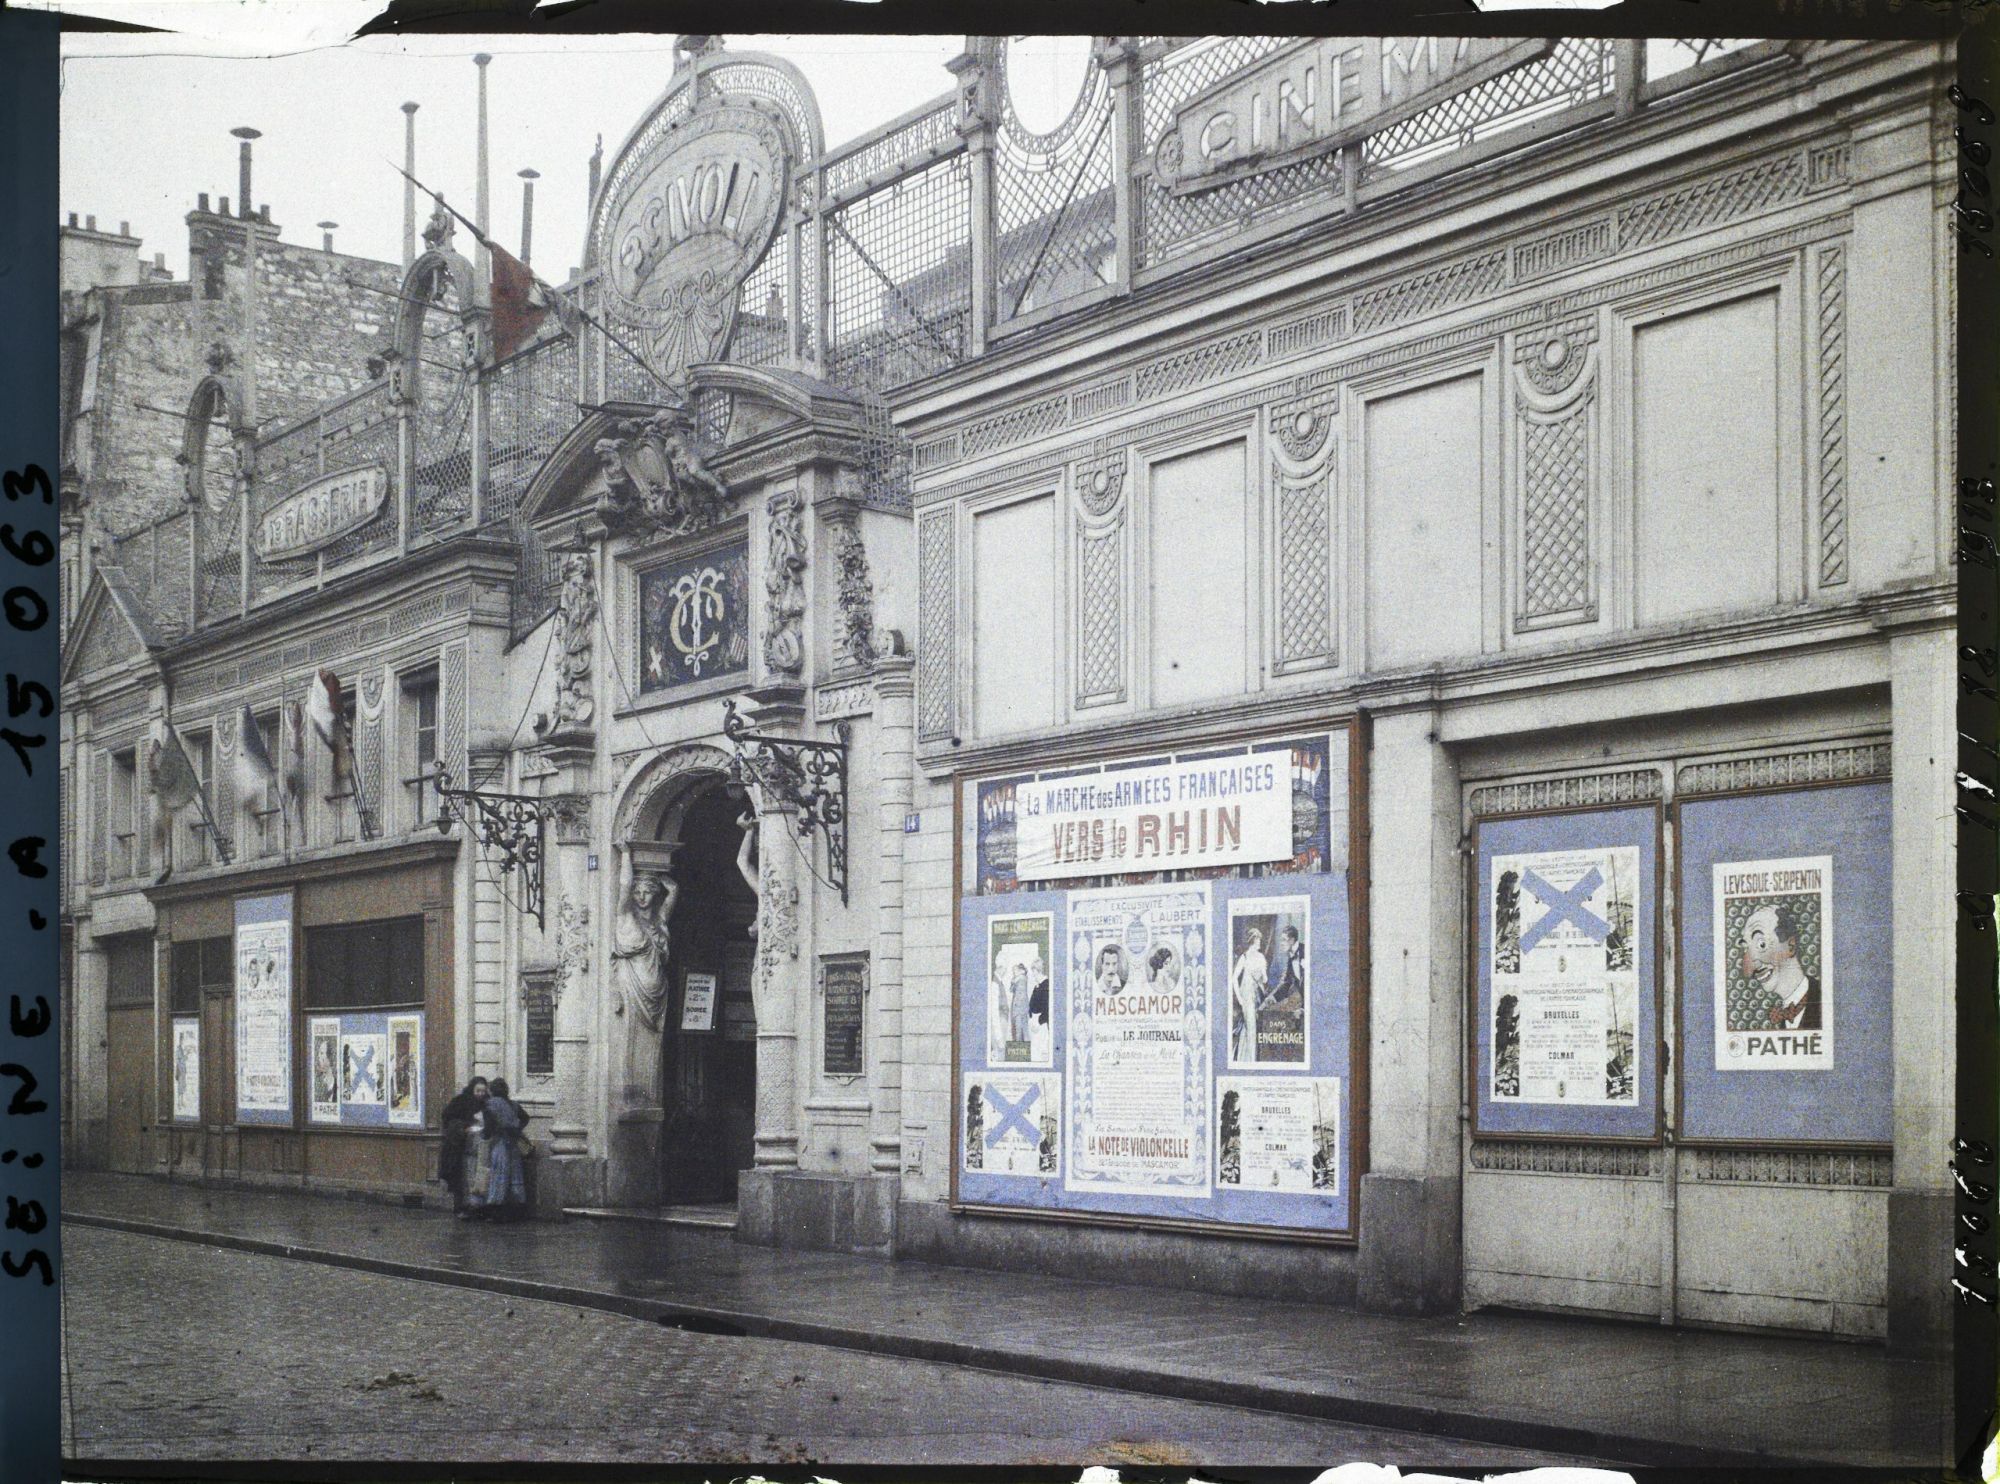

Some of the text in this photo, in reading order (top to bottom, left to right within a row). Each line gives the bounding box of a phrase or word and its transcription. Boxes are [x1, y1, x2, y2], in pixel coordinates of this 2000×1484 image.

[1027, 763, 1274, 816] La MARCHE des ARMÉES FRANÇAISES
[1053, 805, 1241, 864] VERS le RHIN
[1095, 995, 1182, 1016] MASCAMOR
[1544, 1010, 1580, 1019] BRUXELLES
[1123, 1030, 1135, 1041] LE
[1137, 1029, 1181, 1042] JOURNAL
[1257, 1031, 1304, 1045] ENGRENAGE
[1747, 1032, 1823, 1056] PATHÉ
[1548, 1051, 1575, 1060] COLMAR
[1261, 1106, 1291, 1115] BRUXELLES
[1088, 1135, 1189, 1159] LA NOTE DE VIOLONCELLE
[1265, 1143, 1287, 1151] COLMAR
